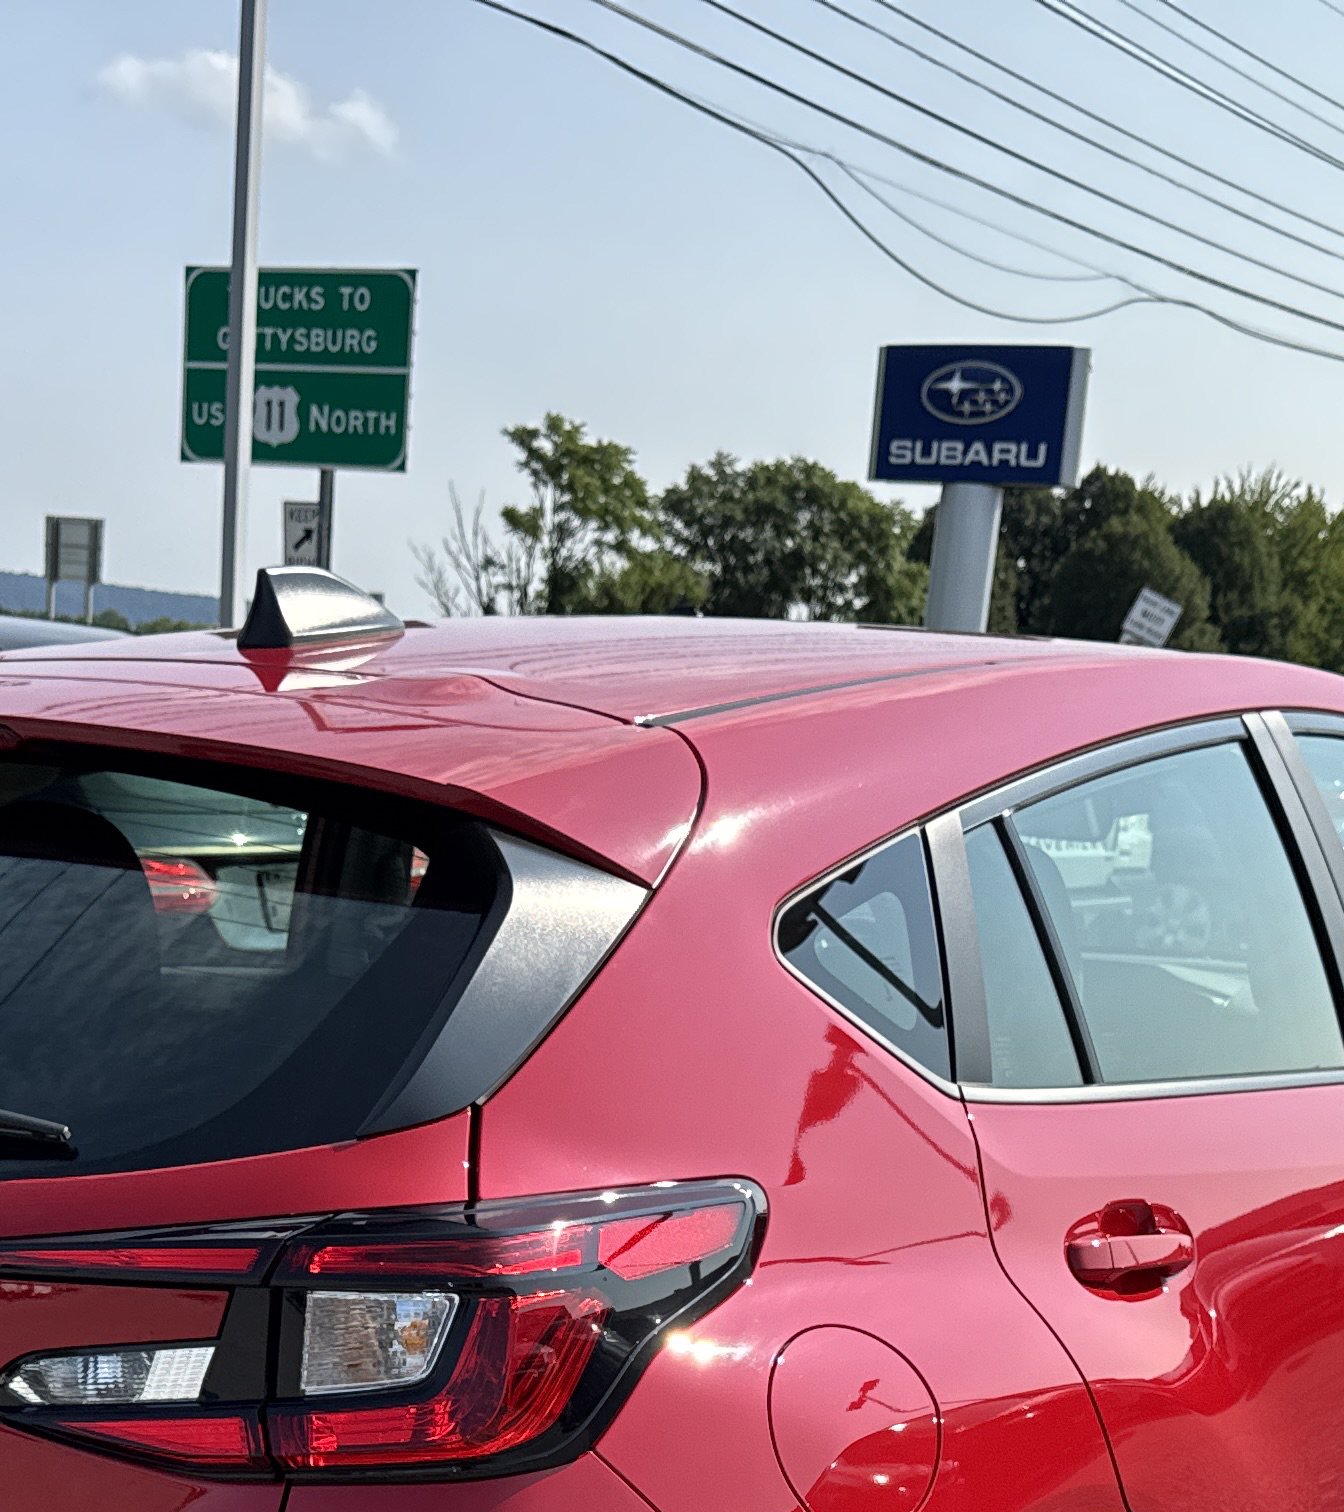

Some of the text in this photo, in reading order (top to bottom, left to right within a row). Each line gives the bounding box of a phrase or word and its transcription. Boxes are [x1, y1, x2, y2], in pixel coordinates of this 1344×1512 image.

[228, 285, 371, 311] UCKS TO
[217, 326, 377, 353] GTYSBURG
[192, 401, 397, 435] US 11 NORTH
[888, 439, 1048, 467] SUBARU
